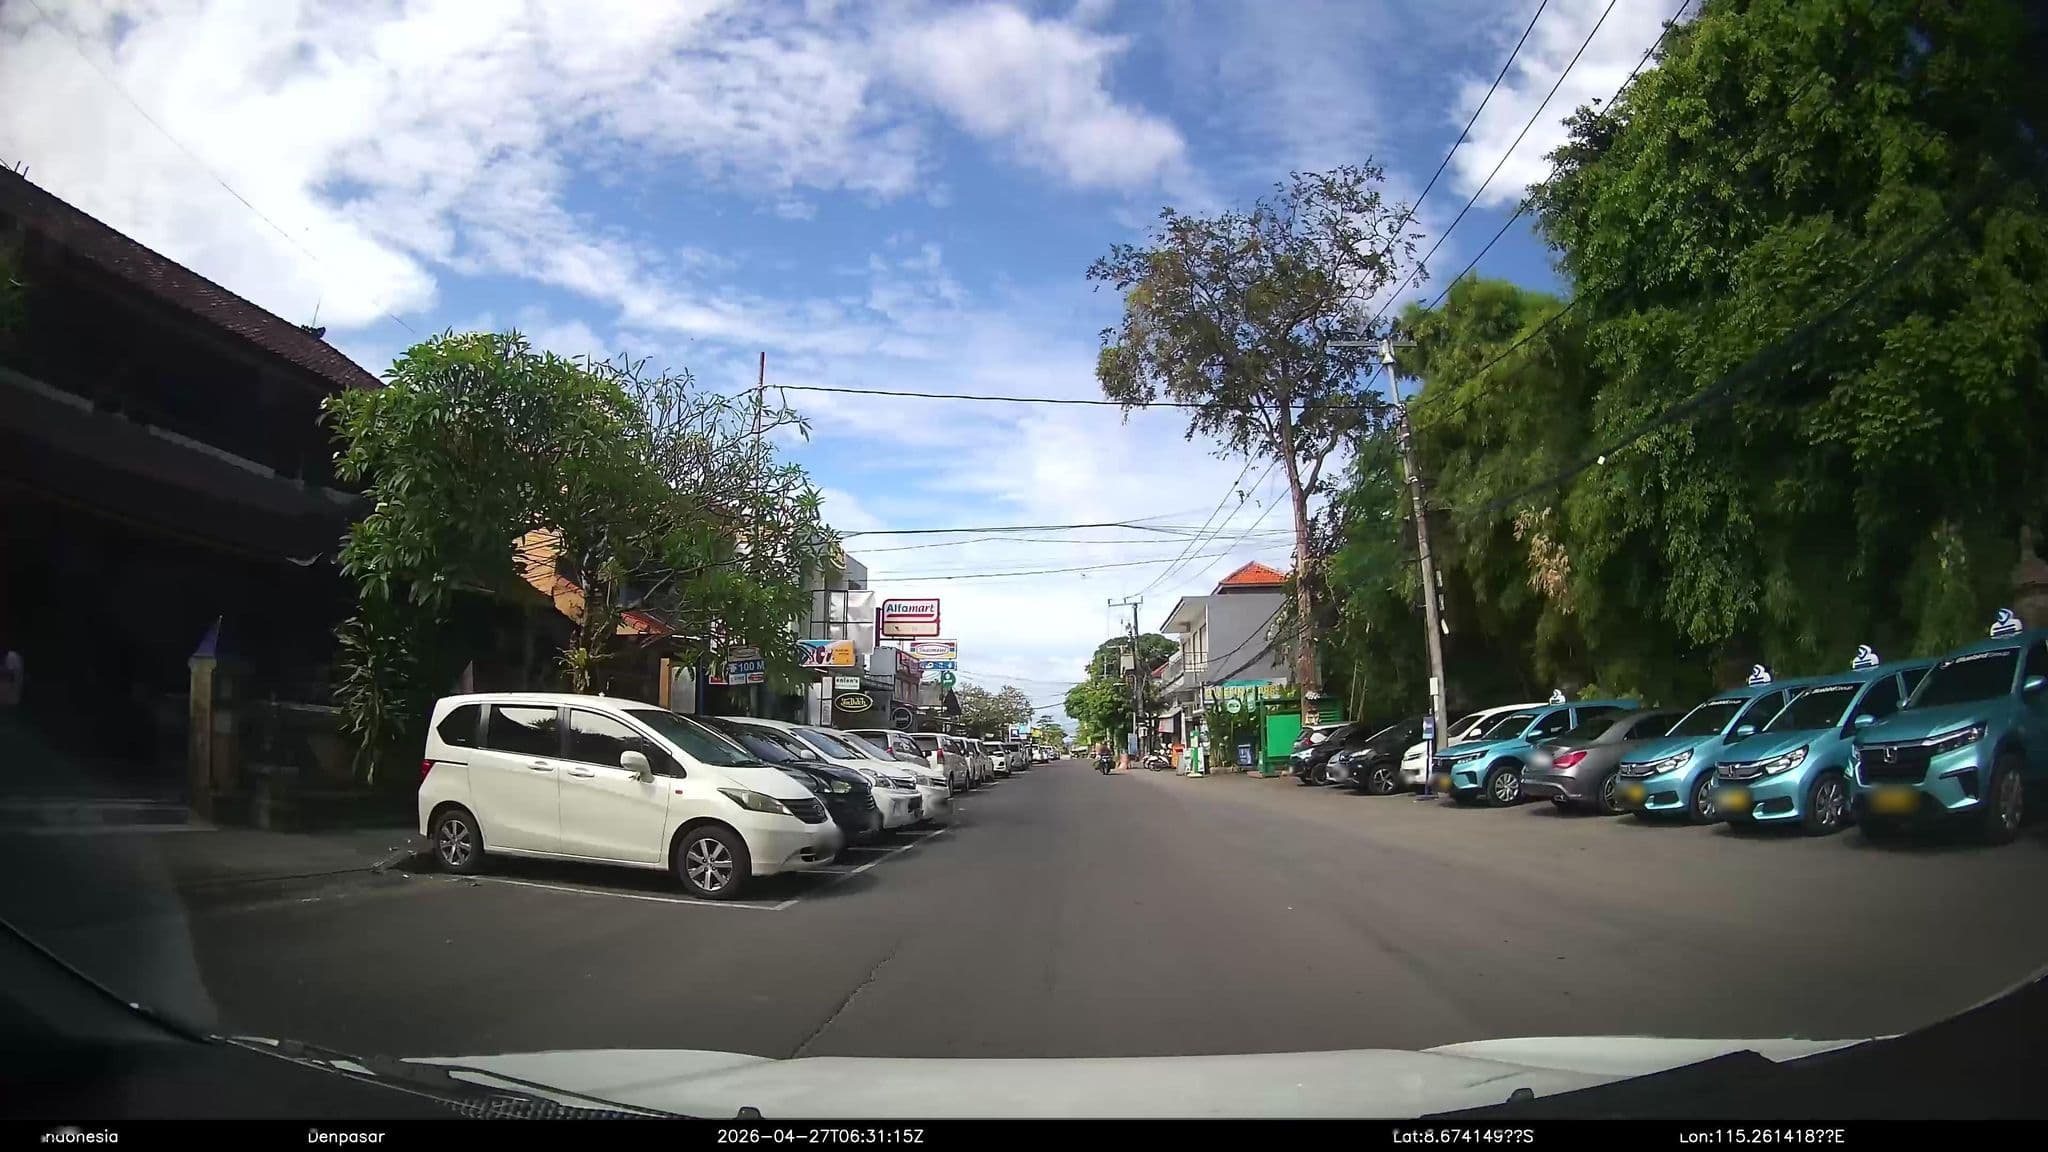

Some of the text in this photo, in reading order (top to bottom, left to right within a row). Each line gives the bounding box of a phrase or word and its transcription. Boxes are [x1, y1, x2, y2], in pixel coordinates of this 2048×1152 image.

[886, 603, 935, 613] Alfamart
[739, 660, 765, 672] 100 M
